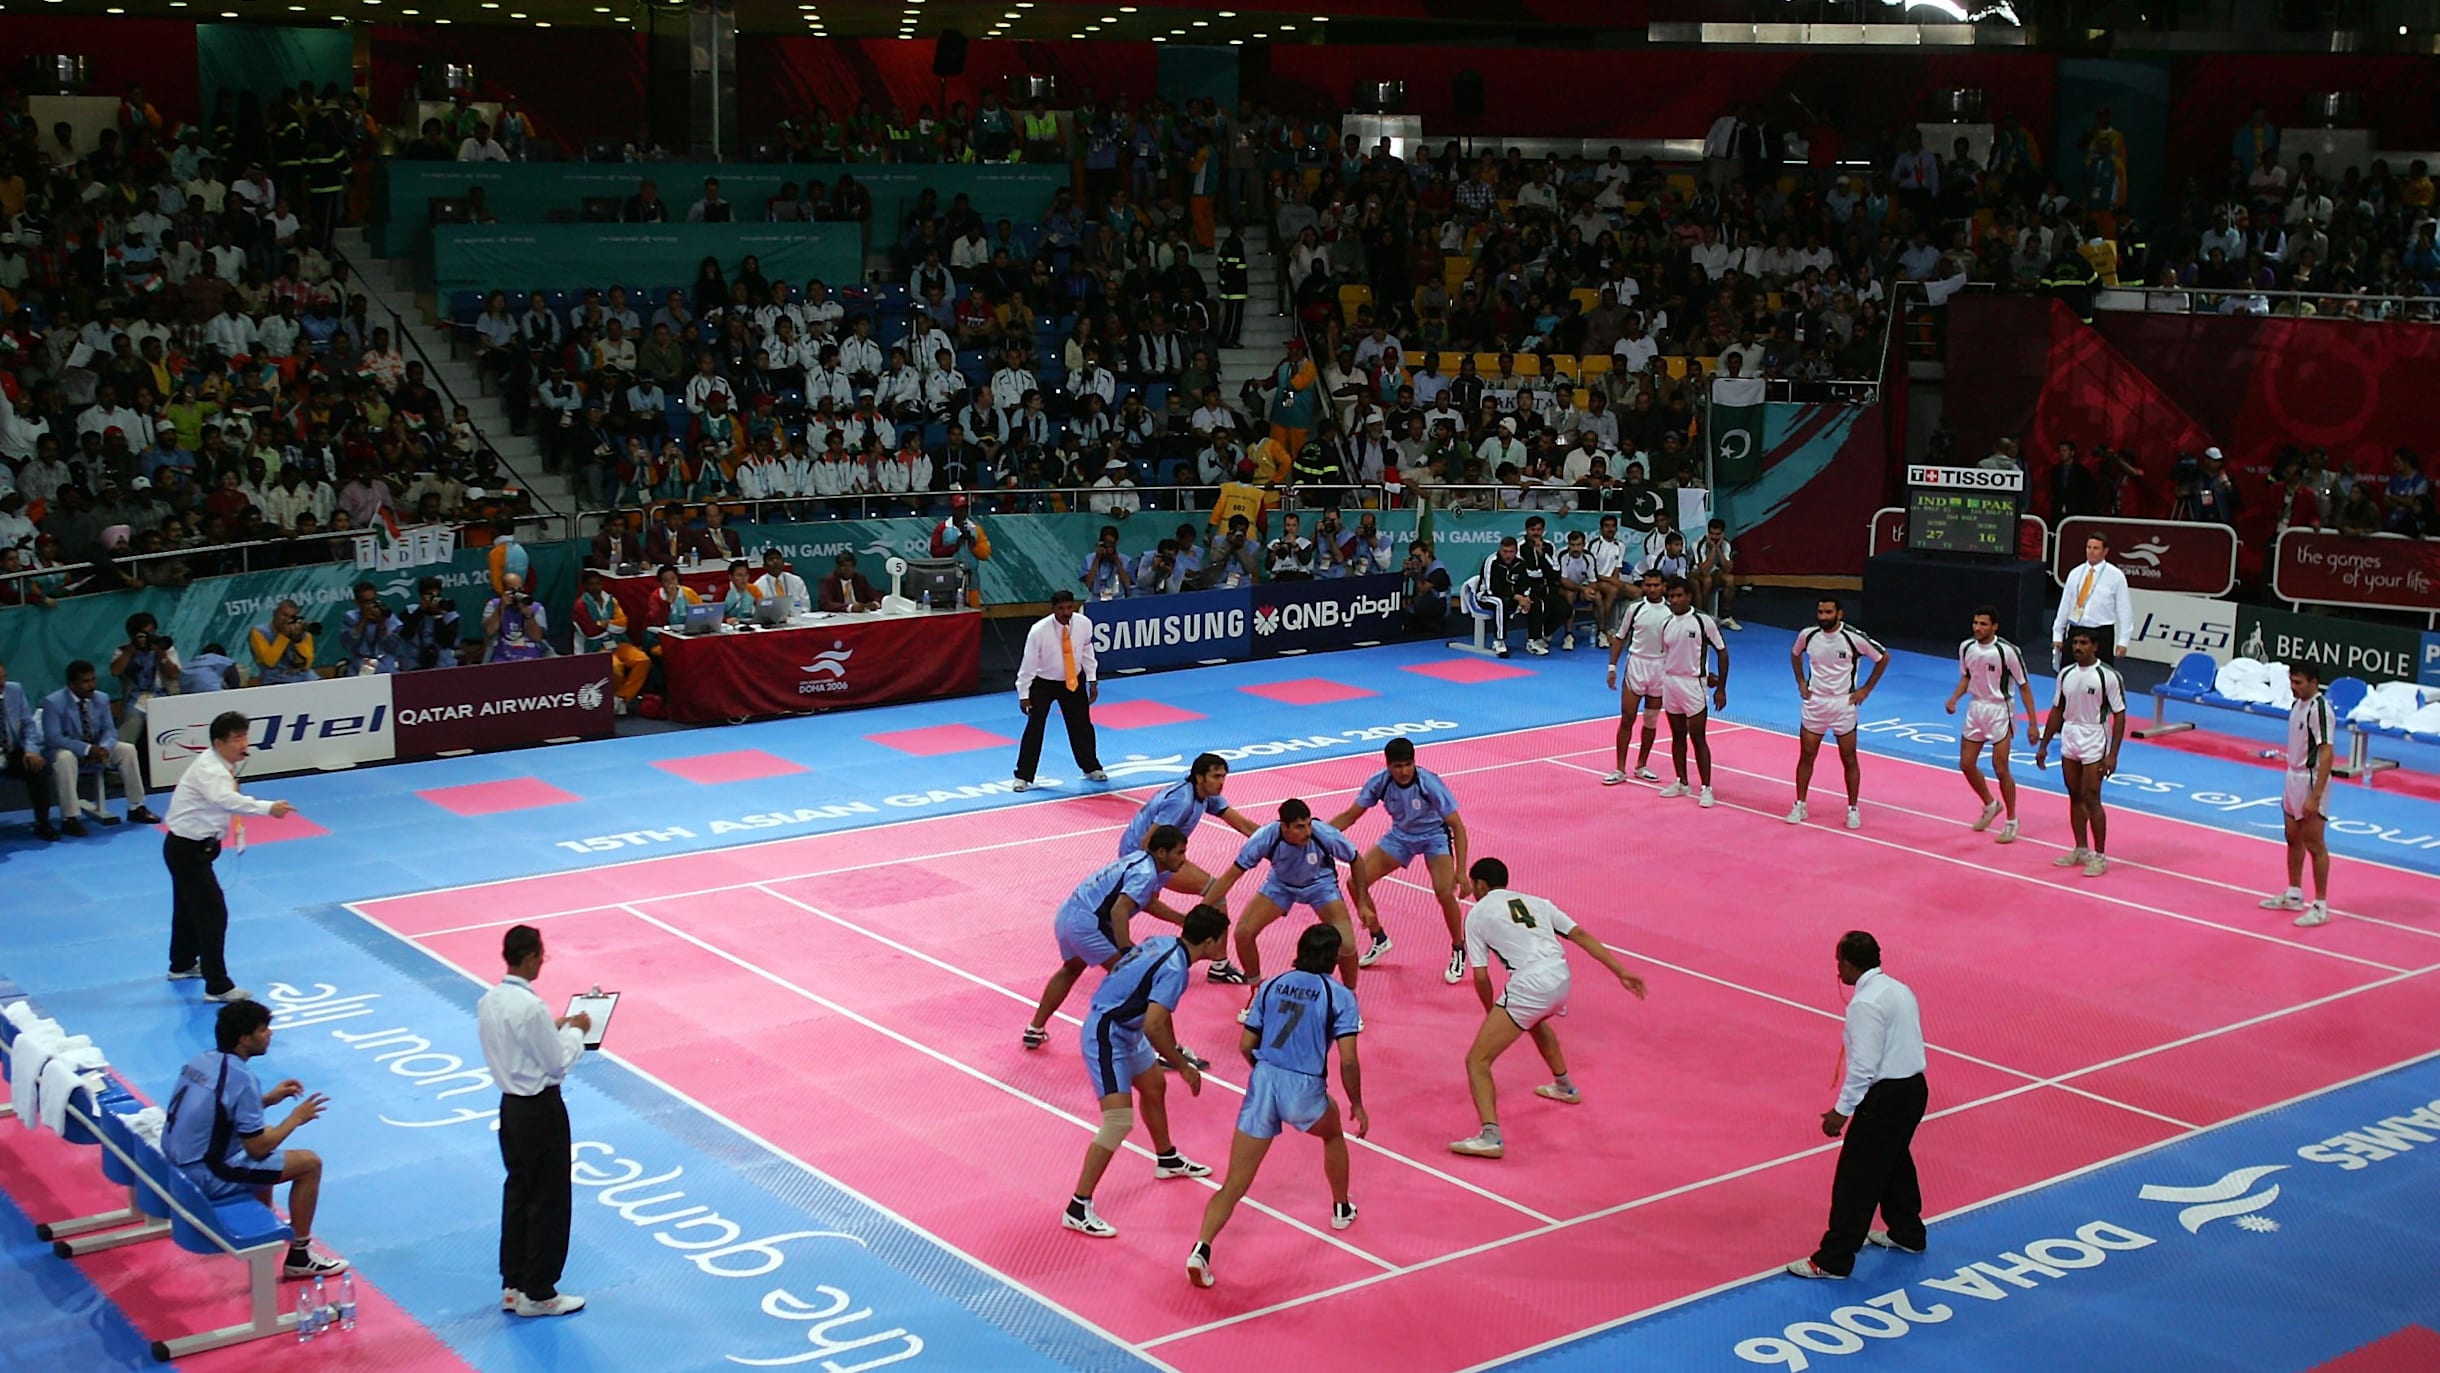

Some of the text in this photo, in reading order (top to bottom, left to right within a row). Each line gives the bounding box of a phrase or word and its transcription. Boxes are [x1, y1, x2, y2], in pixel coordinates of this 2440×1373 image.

[1941, 470, 2020, 487] TISSOT
[1918, 496, 1947, 506] IND
[1982, 500, 2013, 510] PAK
[1398, 531, 1444, 543] ASN
[1450, 531, 1502, 543] GAMES
[1926, 530, 1944, 540] 27
[1979, 533, 1997, 543] 16
[362, 546, 447, 564] INDIA
[896, 562, 902, 572] 5
[2297, 545, 2381, 574] the games
[435, 572, 470, 588] OHA
[2343, 567, 2360, 588] of
[2364, 575, 2402, 593] your
[225, 597, 260, 616] 15TH
[316, 586, 355, 603] GAM
[1341, 592, 1400, 627] الوطني
[1282, 601, 1339, 631] QNB
[1094, 609, 1244, 653] SAMSUNG
[2277, 635, 2410, 677] BEAN POLE
[799, 684, 825, 694] DOHA
[826, 682, 848, 691] 2006
[398, 693, 576, 725] QATAR AIRWAYS
[1214, 719, 1459, 761] DOHA 2006
[1857, 718, 1956, 743] the
[556, 826, 697, 853] 15TH
[709, 800, 880, 835] ASIAN
[1507, 898, 1537, 929] 4
[1275, 984, 1321, 1002] RAKESH
[1271, 999, 1306, 1049] 7
[2297, 1099, 2440, 1170] AMES
[1733, 1220, 2157, 1373] DOHA 2006
